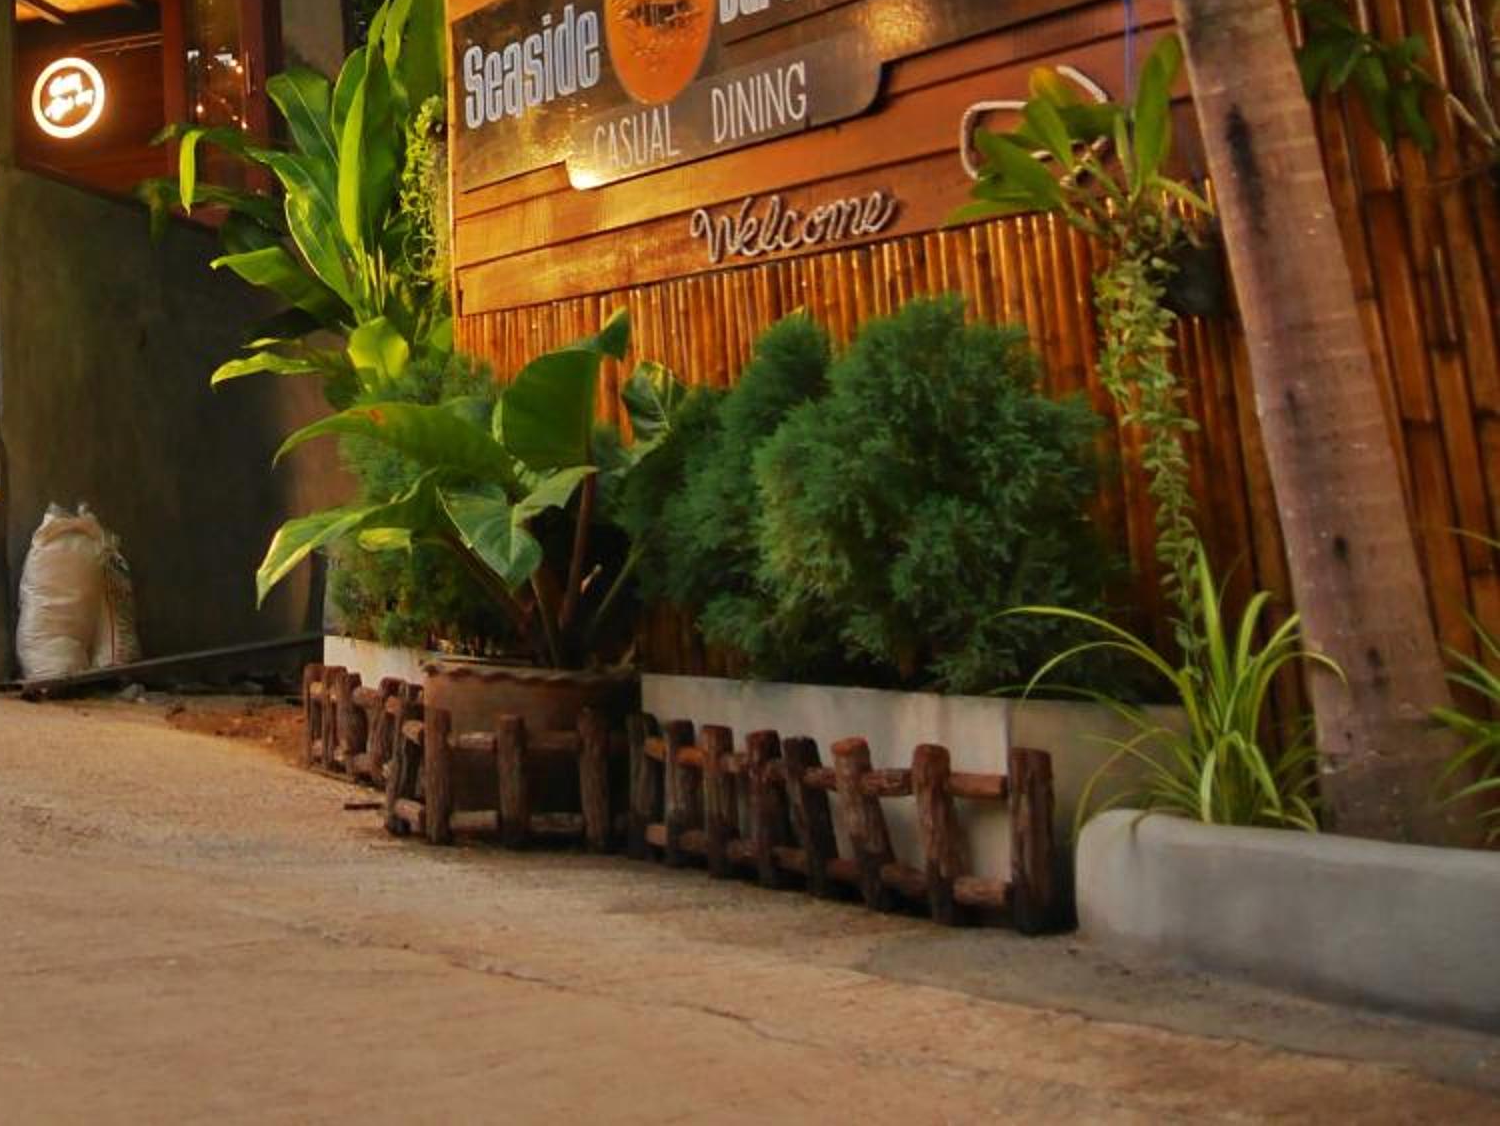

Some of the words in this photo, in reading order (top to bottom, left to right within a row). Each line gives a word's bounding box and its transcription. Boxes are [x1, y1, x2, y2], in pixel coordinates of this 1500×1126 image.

[463, 4, 599, 129] Seaside
[593, 106, 681, 169] CASUAL
[712, 61, 807, 144] DINING
[690, 190, 898, 264] Welcome
